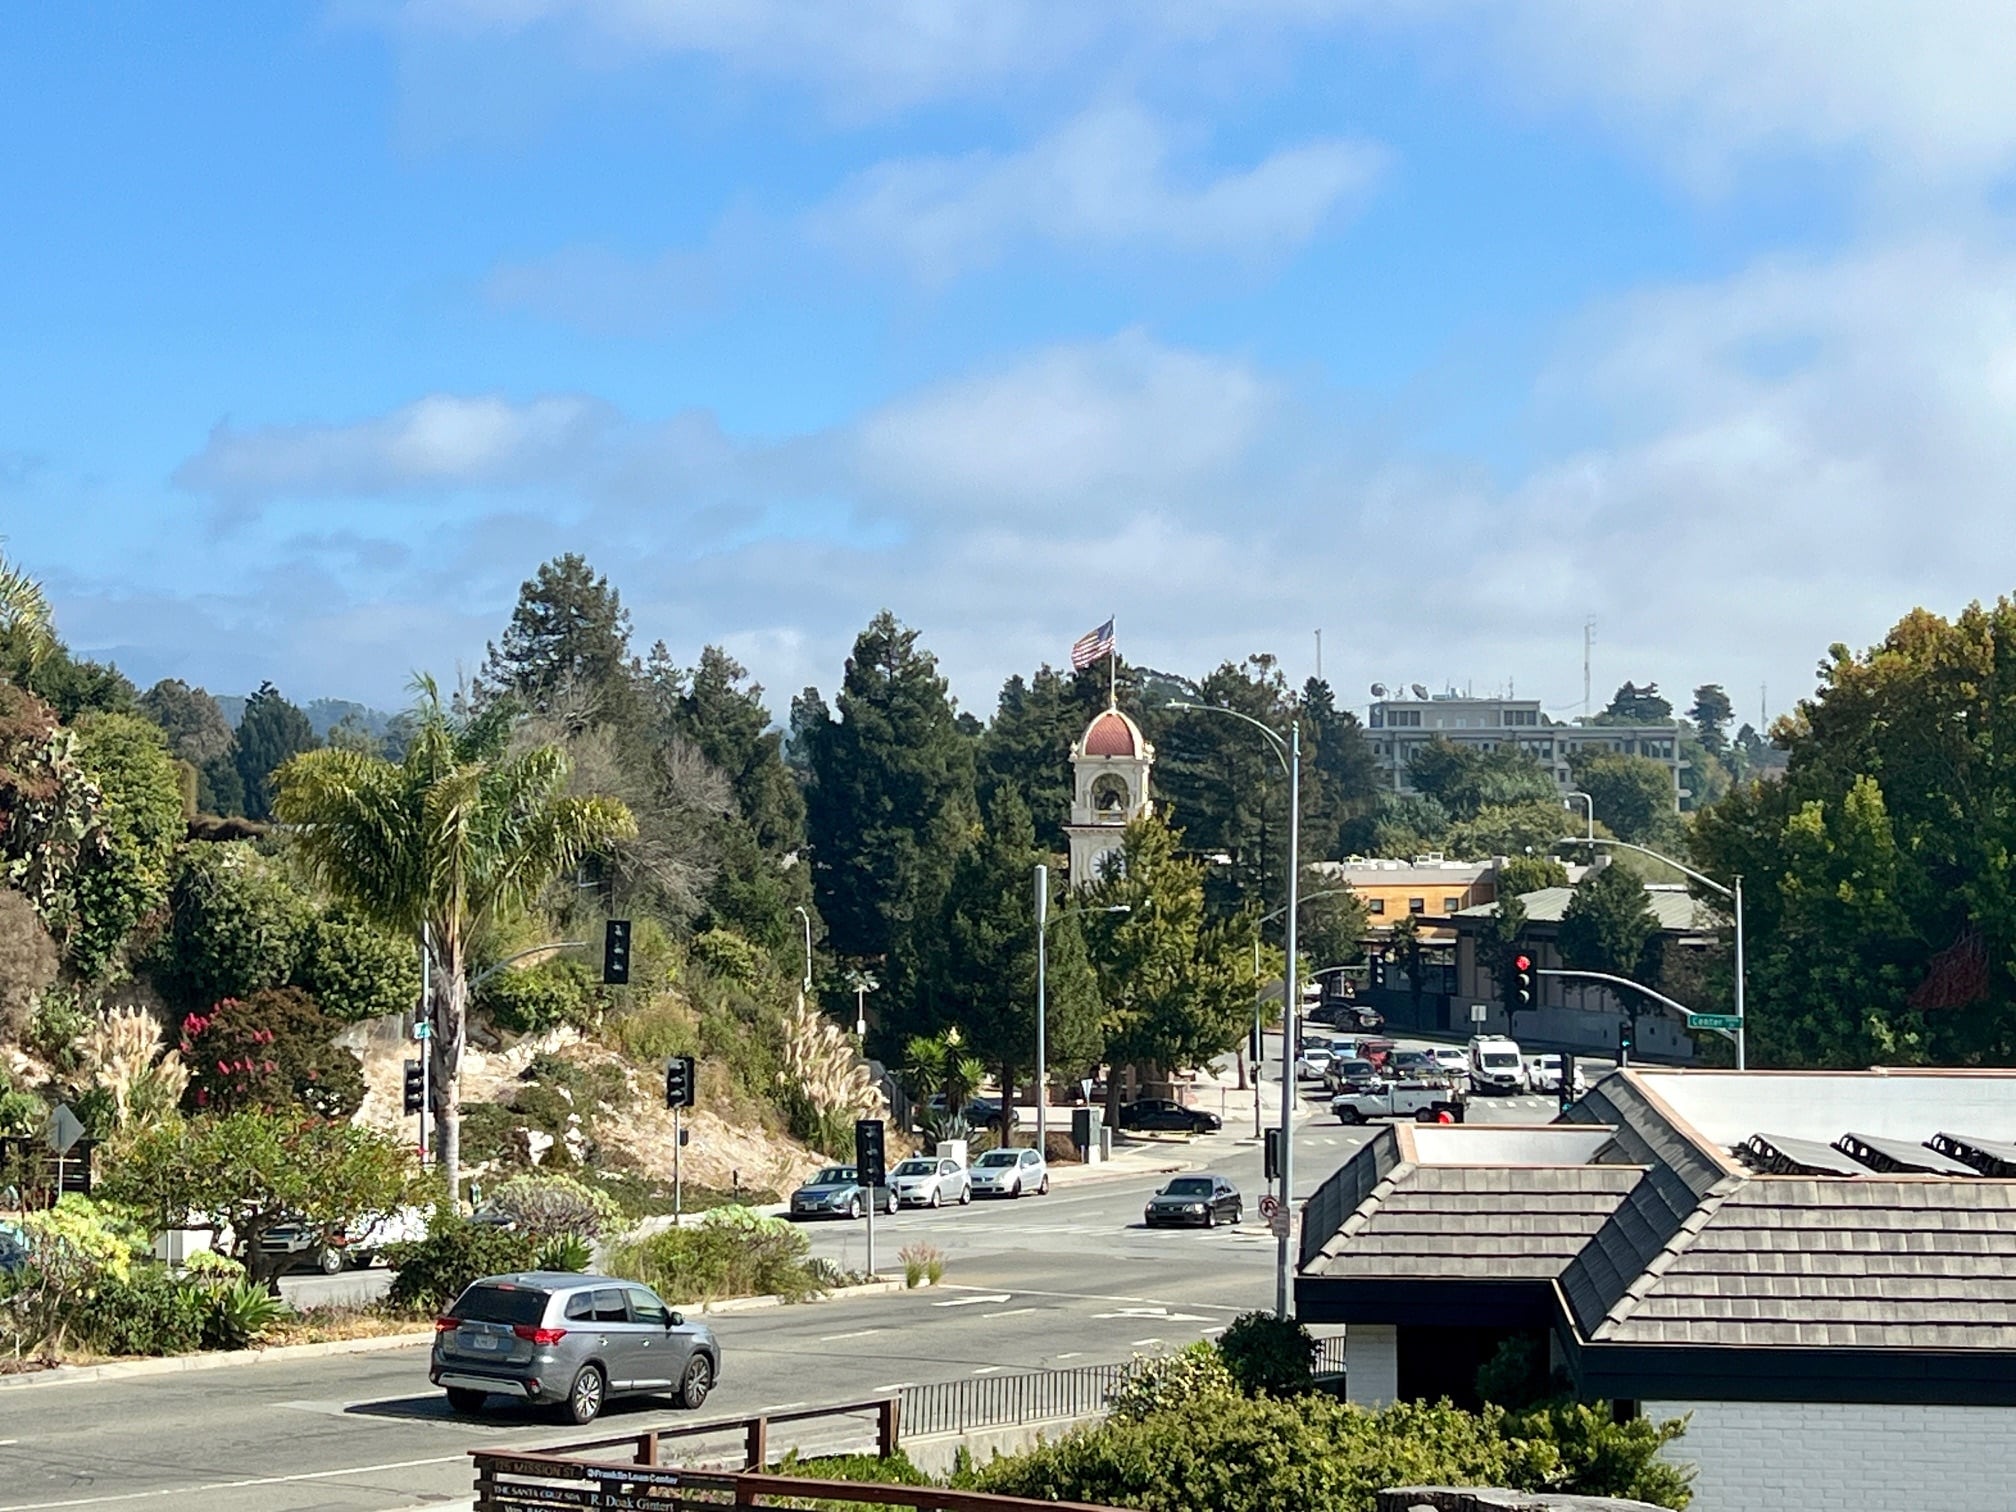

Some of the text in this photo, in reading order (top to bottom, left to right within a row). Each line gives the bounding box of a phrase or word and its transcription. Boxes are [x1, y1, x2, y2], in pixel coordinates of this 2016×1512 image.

[1692, 1016, 1723, 1026] Center
[513, 1462, 561, 1476] MISSION
[649, 1473, 678, 1485] Center
[493, 1485, 510, 1495] THE
[511, 1487, 538, 1497] SANTA
[539, 1489, 563, 1499] CRUZ
